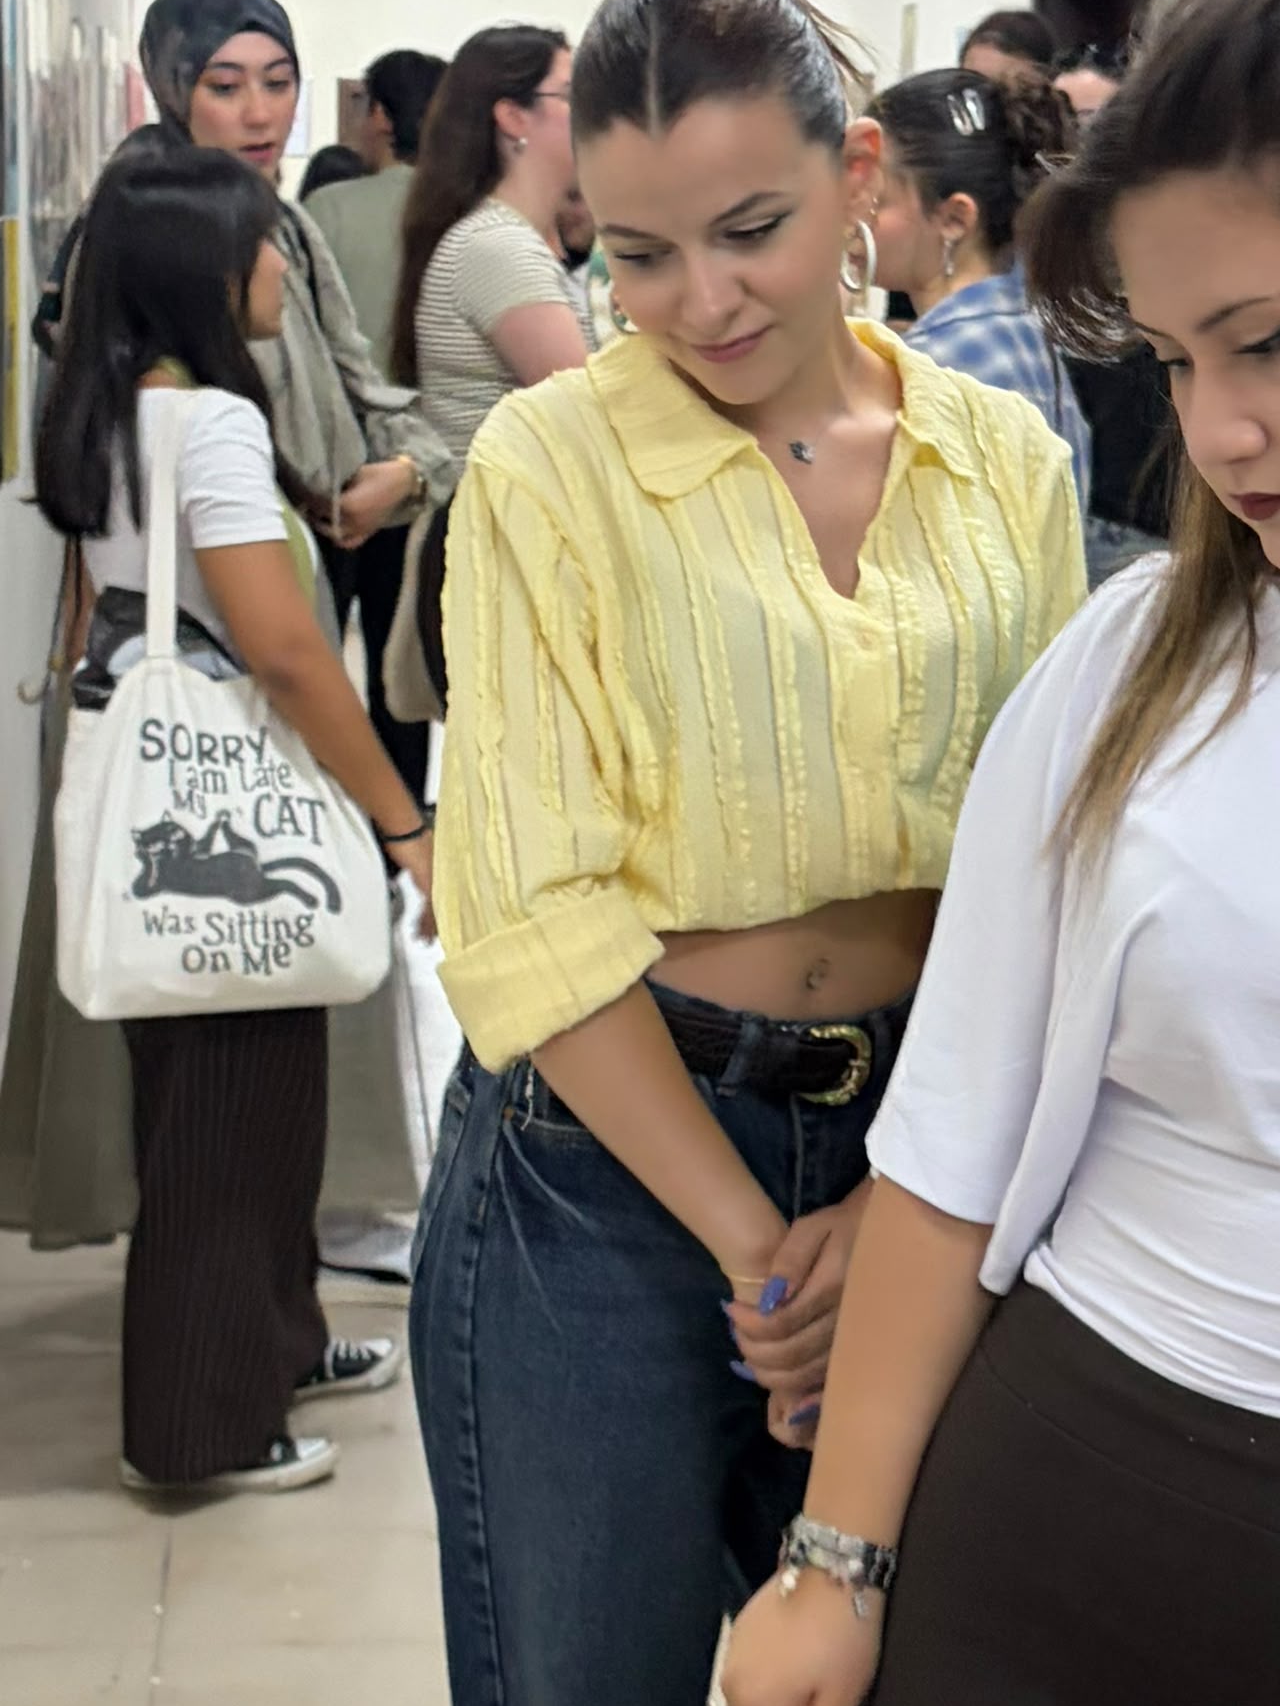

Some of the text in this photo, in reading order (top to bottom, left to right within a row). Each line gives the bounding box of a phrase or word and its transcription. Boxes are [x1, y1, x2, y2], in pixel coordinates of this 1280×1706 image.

[140, 718, 269, 766] SORRY
[186, 765, 229, 795] am
[172, 789, 327, 847] My CAT
[142, 905, 317, 948] Was Sitting
[180, 942, 294, 976] On Me
